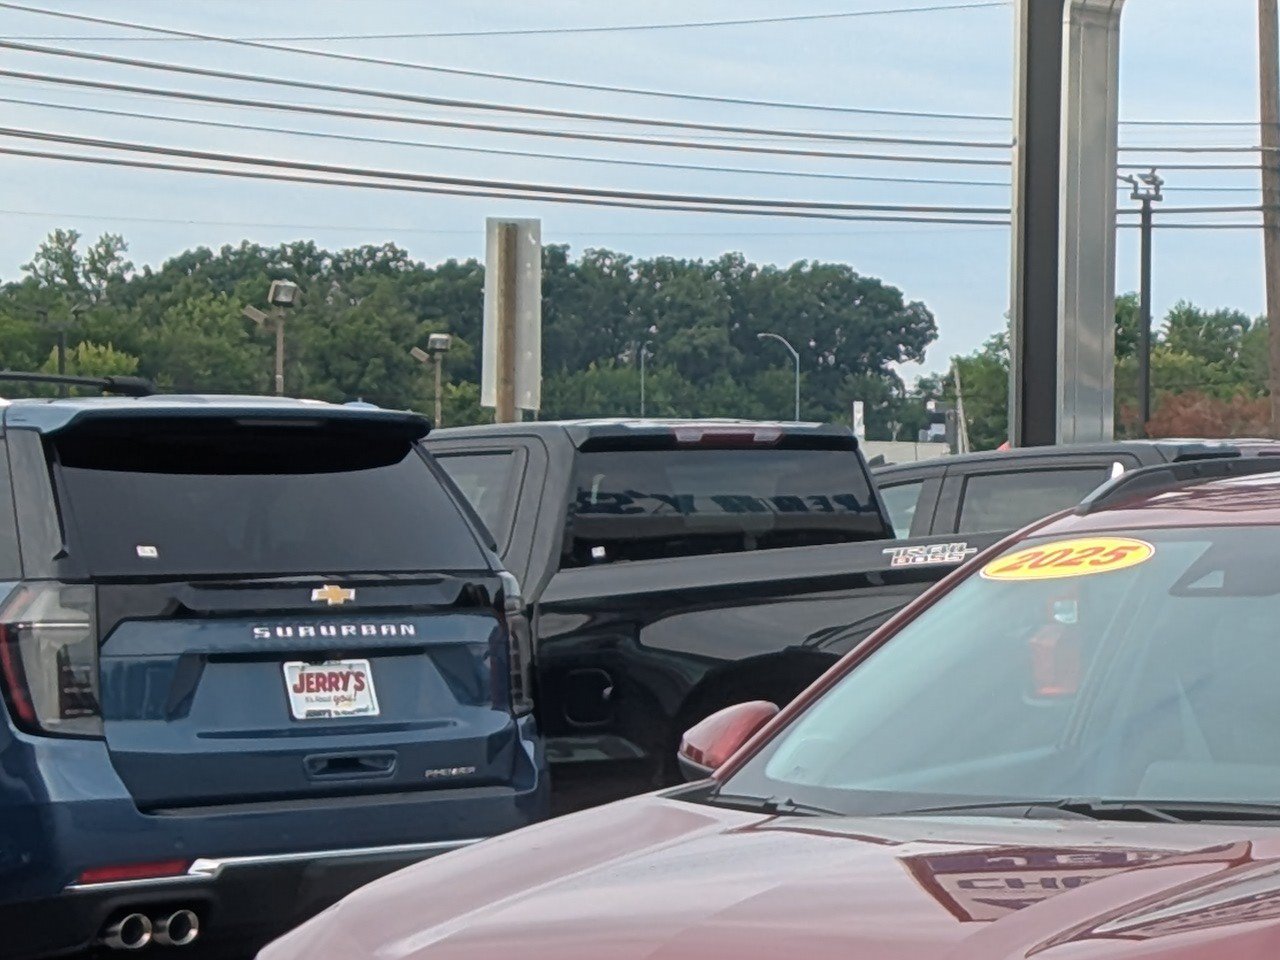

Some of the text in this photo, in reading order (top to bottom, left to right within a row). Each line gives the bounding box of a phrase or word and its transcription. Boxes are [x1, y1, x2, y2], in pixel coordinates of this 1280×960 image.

[992, 546, 1140, 573] 2025
[253, 624, 416, 639] SUBURBAN
[293, 671, 366, 693] JERRY'S
